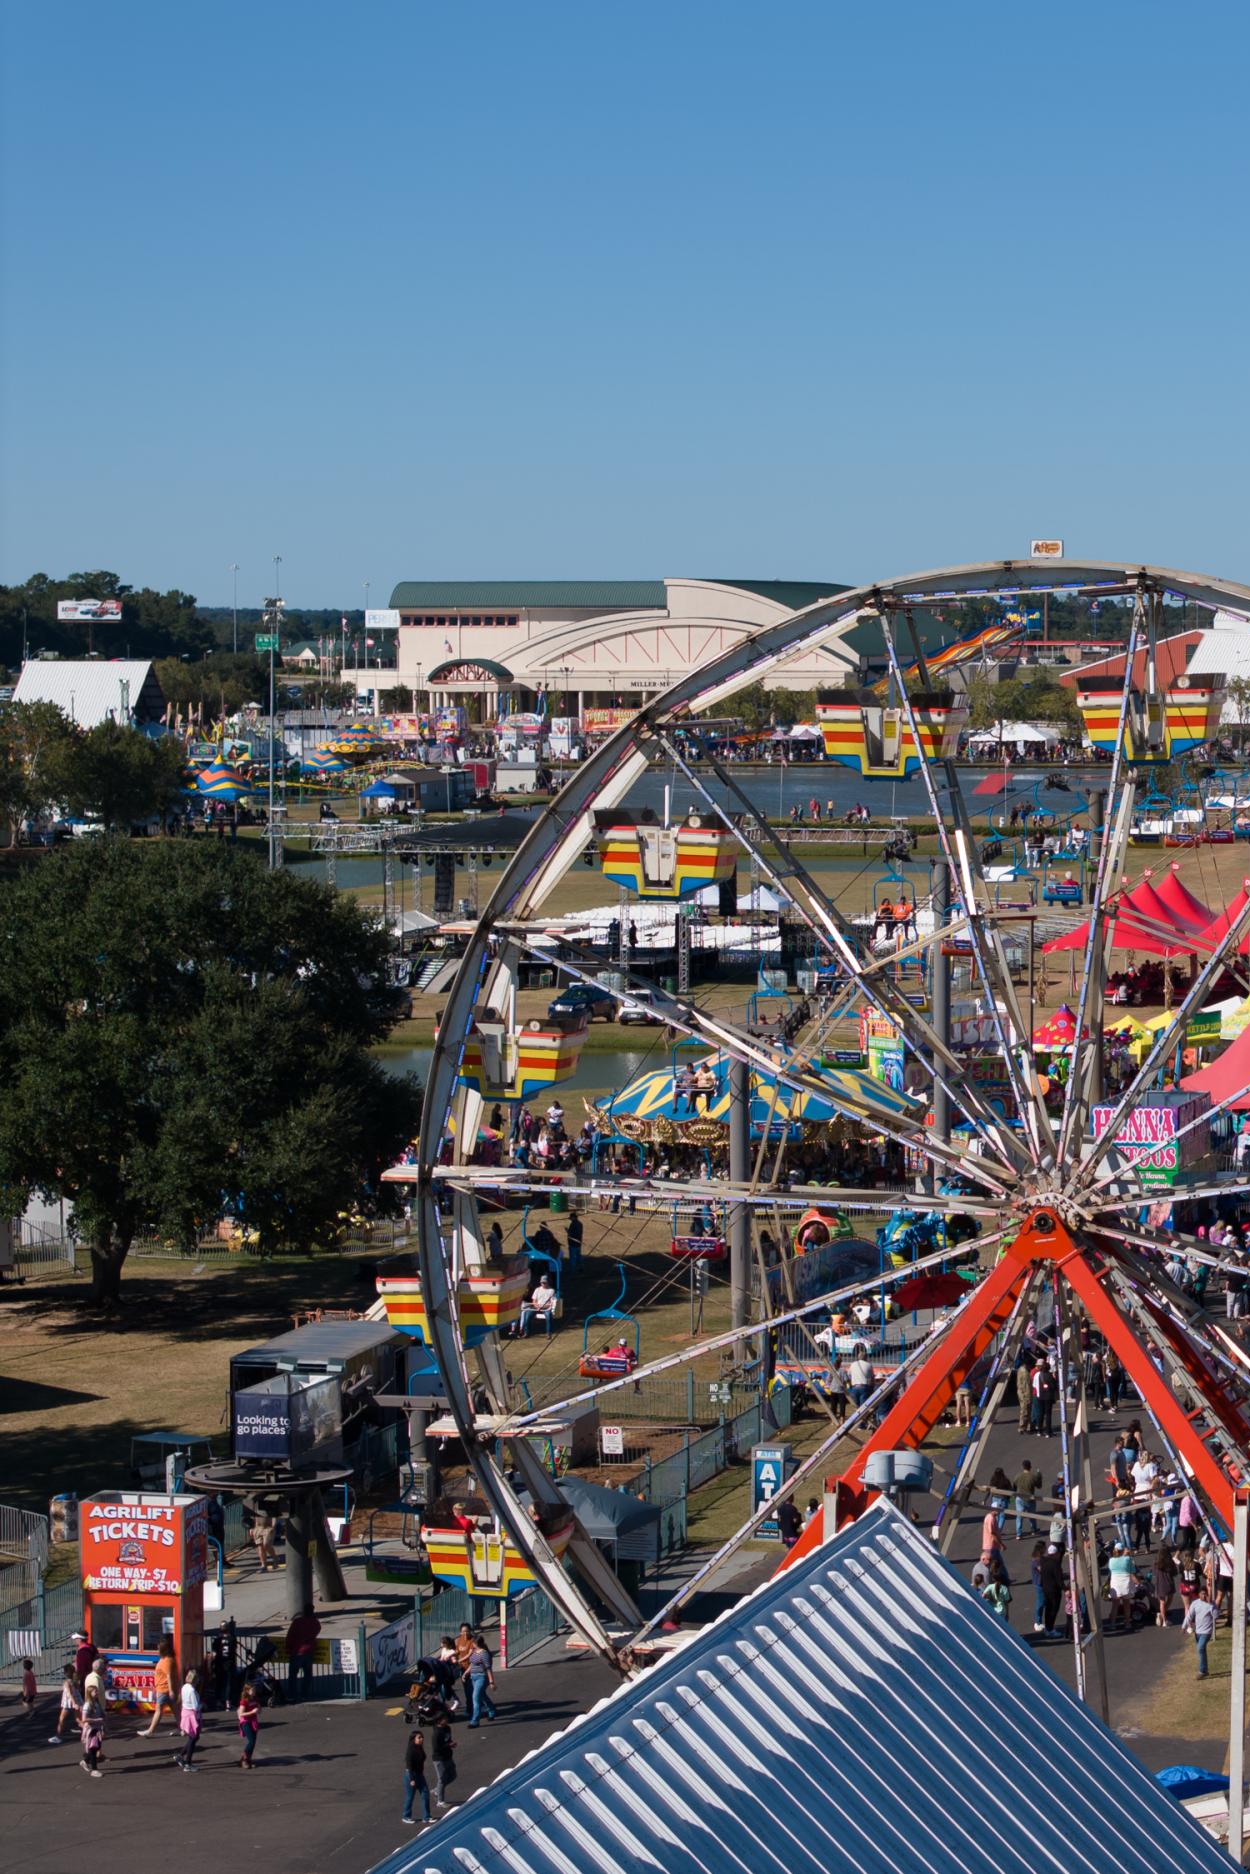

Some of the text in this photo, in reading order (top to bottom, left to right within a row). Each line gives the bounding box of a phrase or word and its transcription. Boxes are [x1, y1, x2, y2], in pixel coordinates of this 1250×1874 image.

[709, 1383, 719, 1393] NO
[236, 1414, 278, 1428] Looking
[236, 1425, 250, 1435] go
[89, 1505, 175, 1521] AGRILIFT
[89, 1522, 175, 1547] TICKETS
[100, 1566, 122, 1578] ONE
[153, 1568, 167, 1580] $7
[88, 1577, 129, 1589] RETURN
[375, 1632, 408, 1679] Ford
